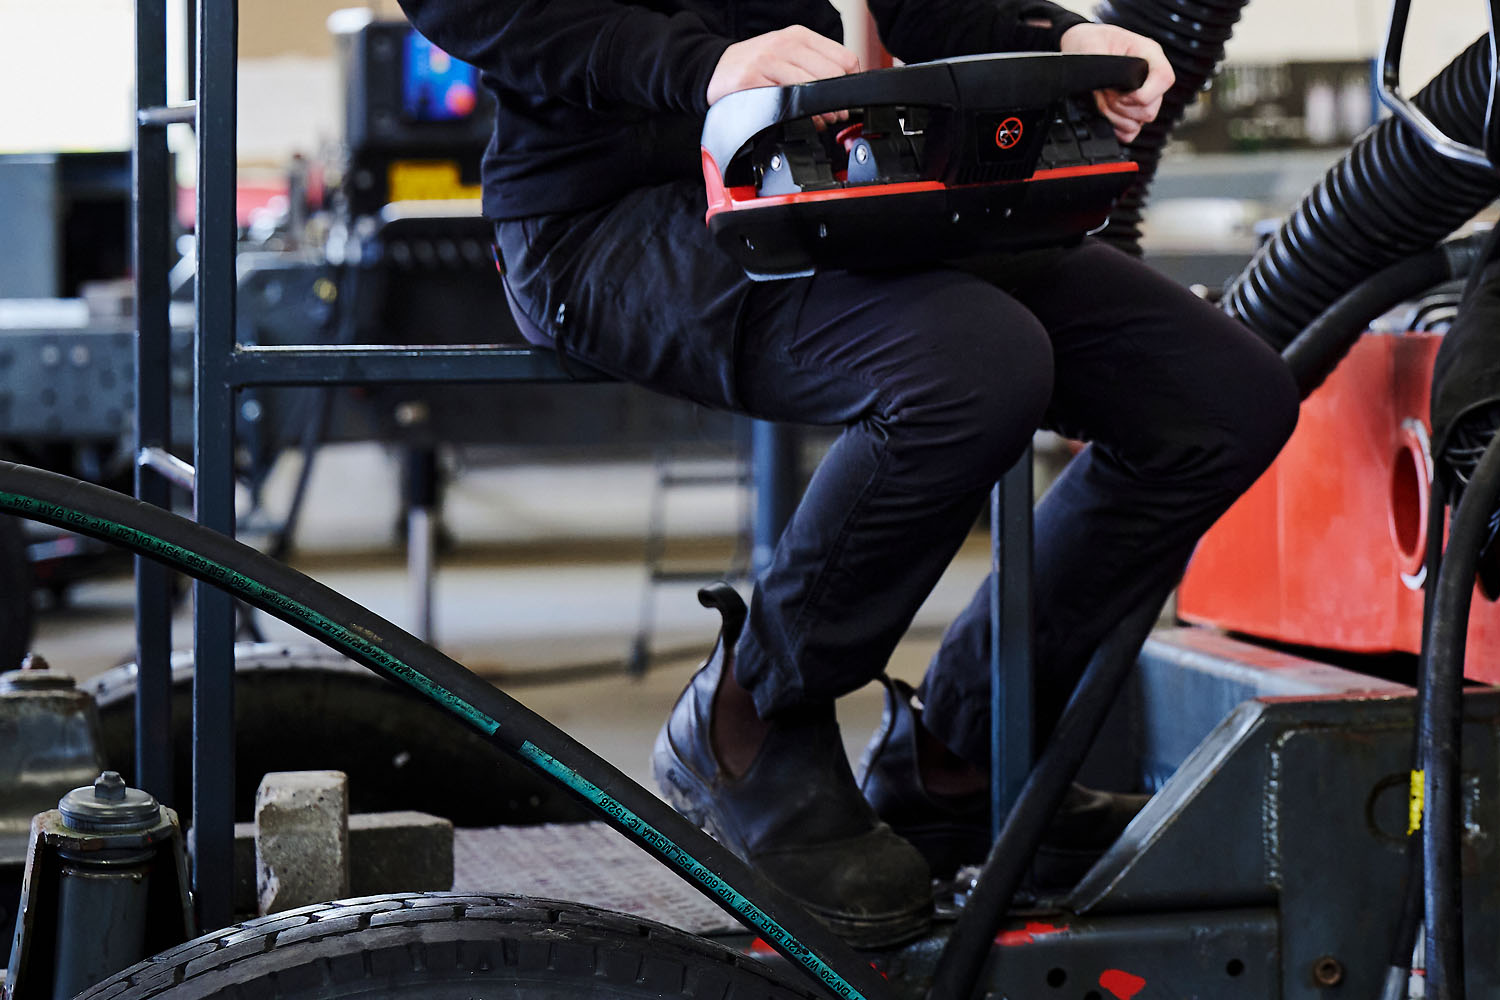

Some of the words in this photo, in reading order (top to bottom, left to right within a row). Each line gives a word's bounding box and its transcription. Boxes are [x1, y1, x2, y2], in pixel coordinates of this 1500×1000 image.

[65, 511, 89, 526] 420
[89, 518, 111, 533] WP
[131, 532, 152, 548] DN
[155, 541, 182, 560] 4SH
[229, 574, 253, 592] 790
[597, 795, 643, 832] IC-152/8
[638, 825, 674, 855] MSHA
[673, 851, 695, 871] PSI
[691, 865, 720, 890] 6090
[716, 884, 737, 903] WP
[759, 917, 785, 941] BAR
[781, 936, 804, 957] 420
[800, 951, 821, 972] WP
[831, 979, 851, 998] DN
